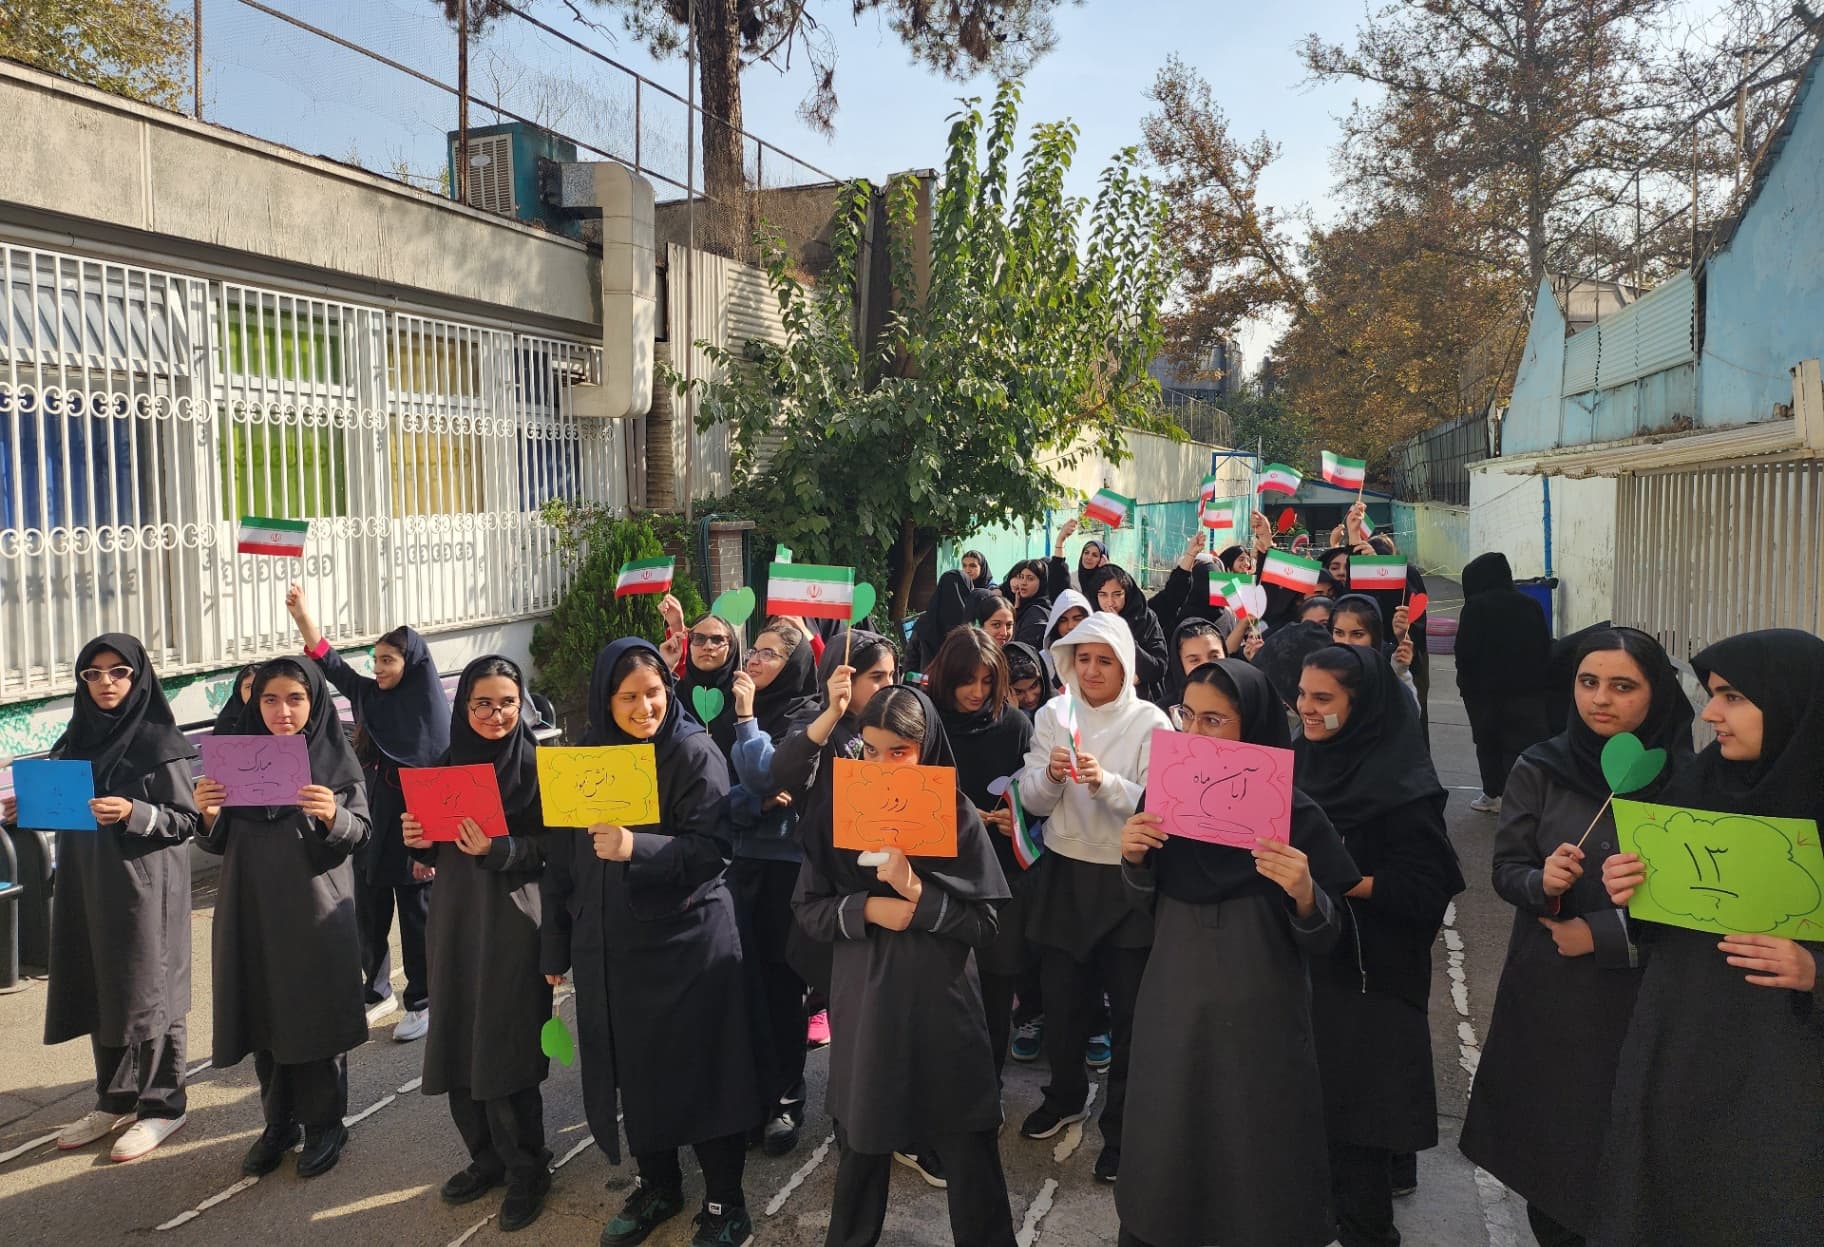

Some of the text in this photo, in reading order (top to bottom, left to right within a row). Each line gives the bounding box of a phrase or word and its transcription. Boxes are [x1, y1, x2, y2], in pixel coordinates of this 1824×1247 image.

[583, 767, 616, 798] دانش
[879, 785, 910, 814] روز
[1192, 765, 1260, 818] آبان ماه
[1683, 842, 1729, 883] ۱۳
